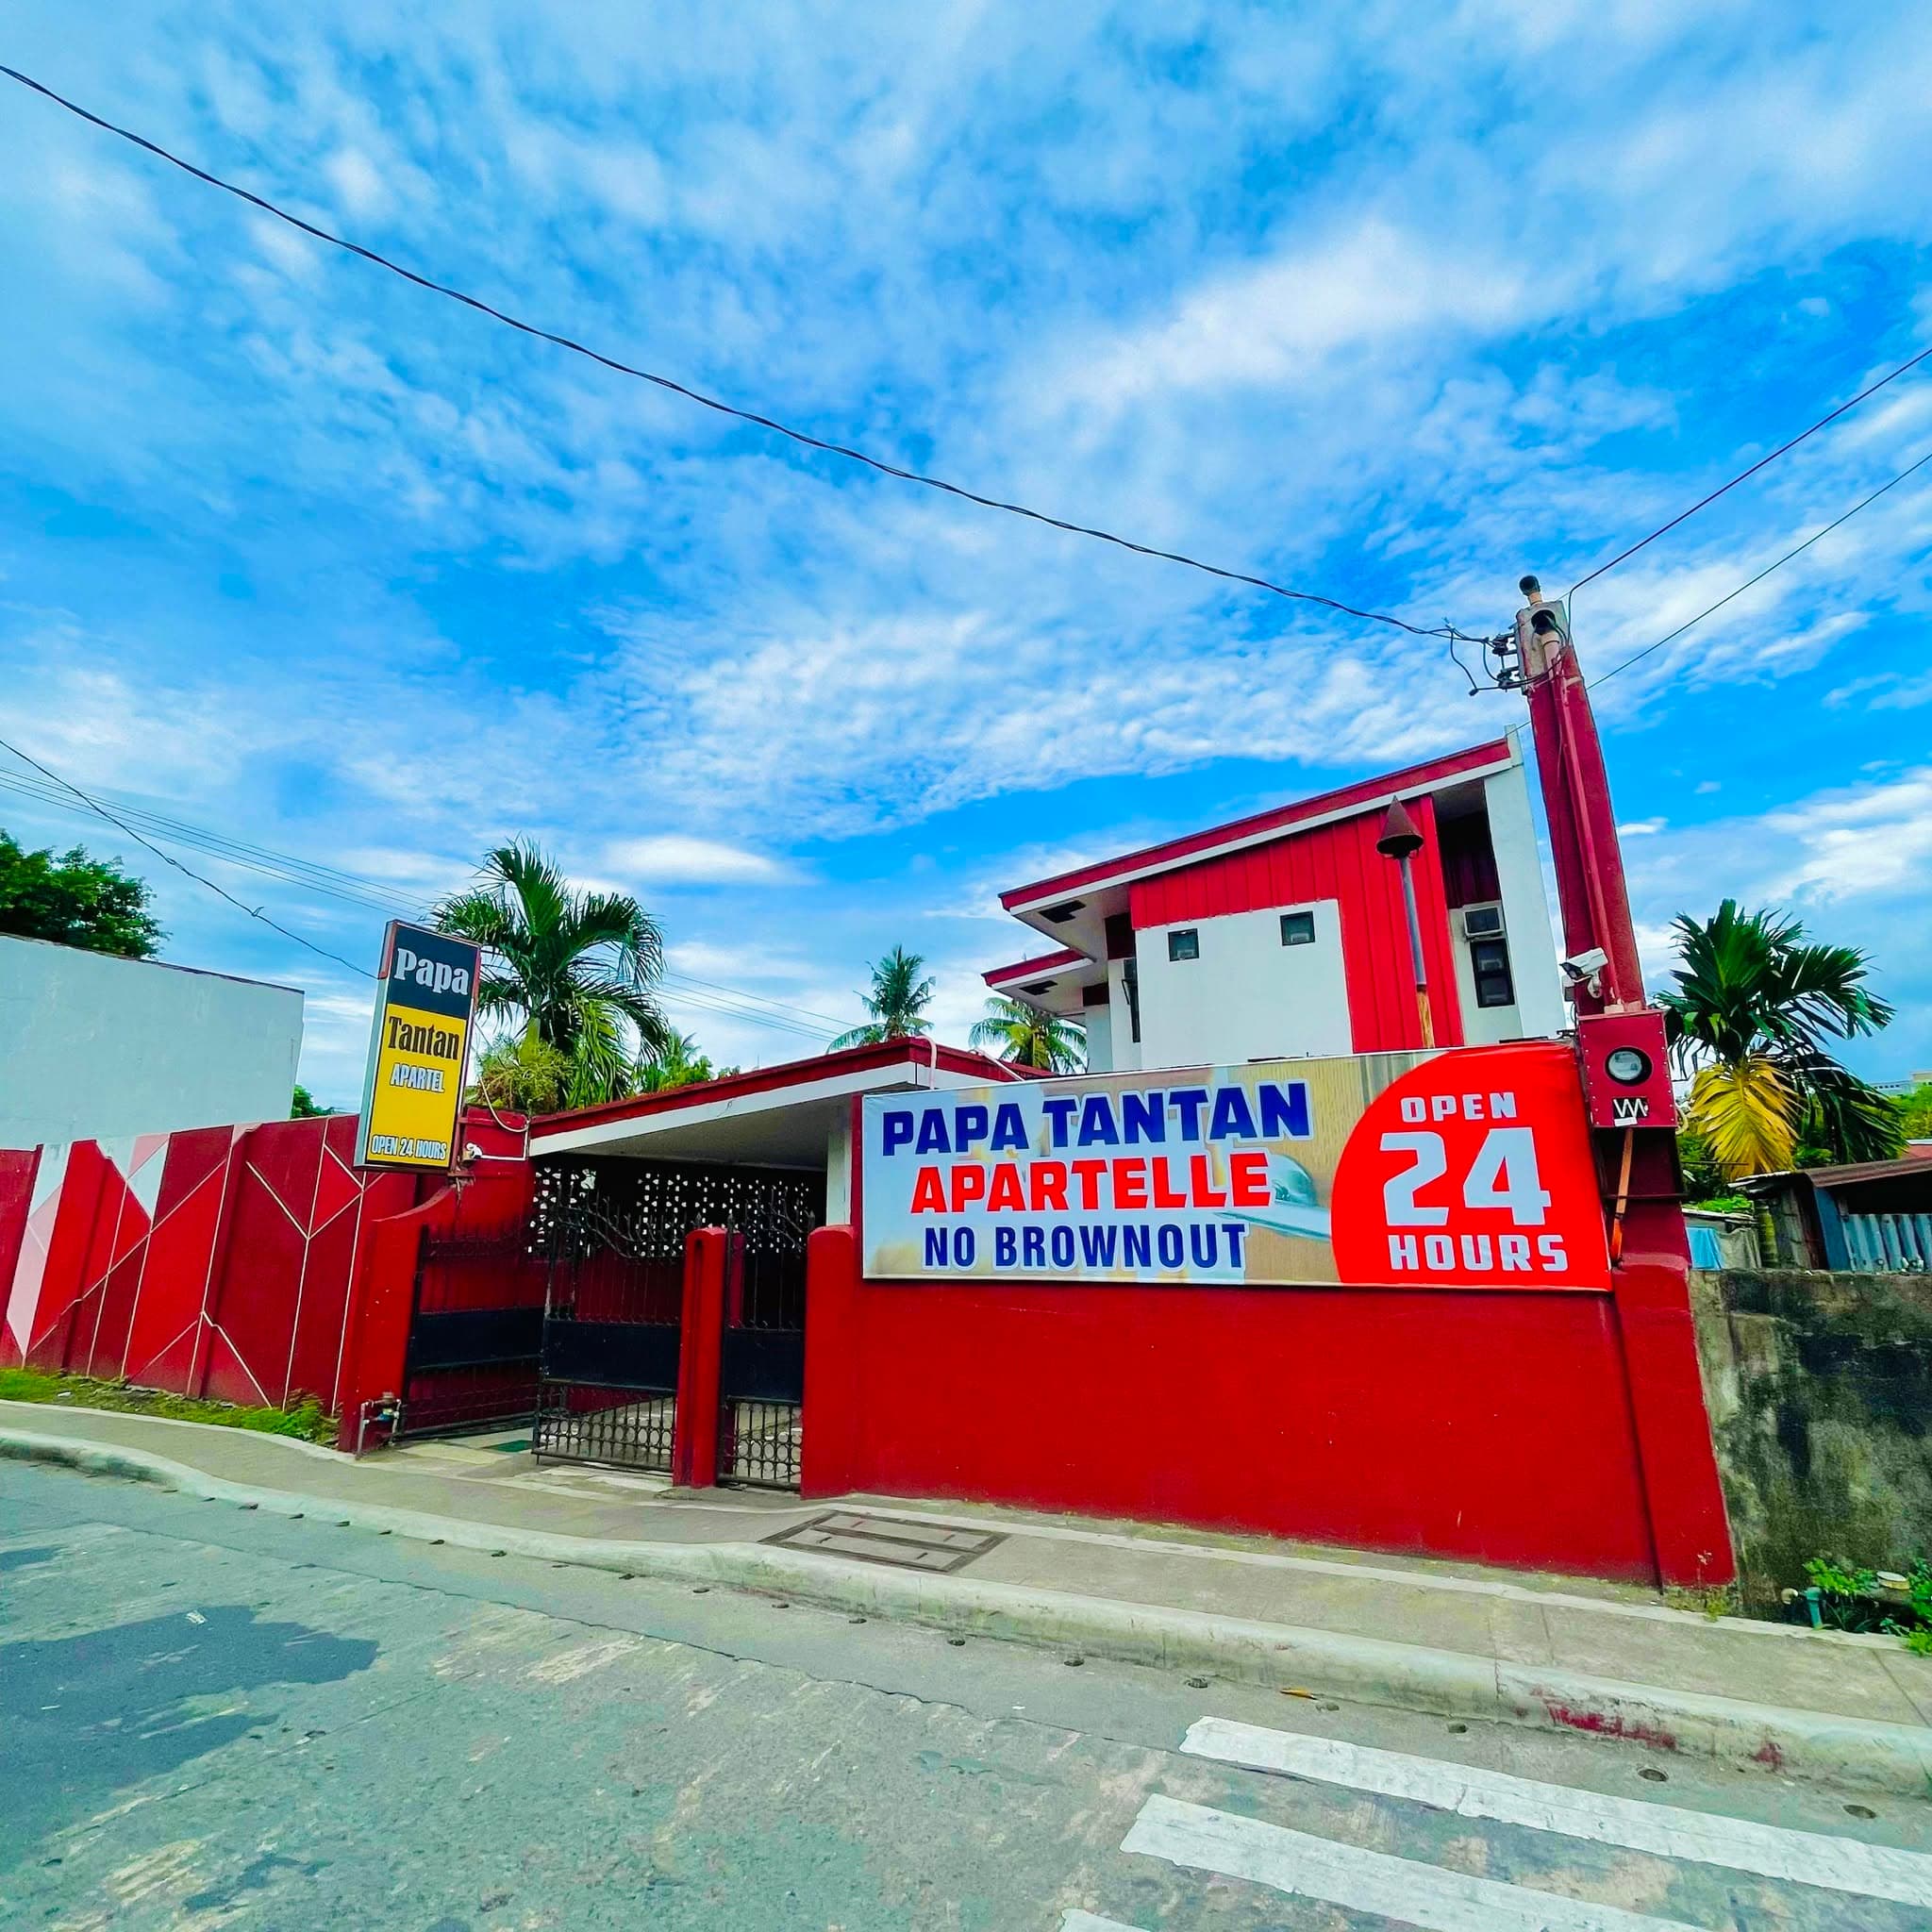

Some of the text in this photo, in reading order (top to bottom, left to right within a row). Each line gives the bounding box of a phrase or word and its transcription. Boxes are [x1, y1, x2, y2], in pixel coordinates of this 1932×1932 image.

[394, 947, 470, 996] Papa
[387, 1016, 459, 1060] Tantan
[390, 1062, 445, 1093] APARTEL
[882, 1082, 1310, 1157] PAPA TANTAN
[1400, 1091, 1517, 1124] OPEN
[372, 1134, 447, 1160] OPEN 24 HOURS
[910, 1151, 1271, 1214] APARTELLE
[1379, 1126, 1552, 1226] 24
[924, 1223, 1246, 1270] NO BROWNOUT
[1388, 1234, 1568, 1273] HOURS
